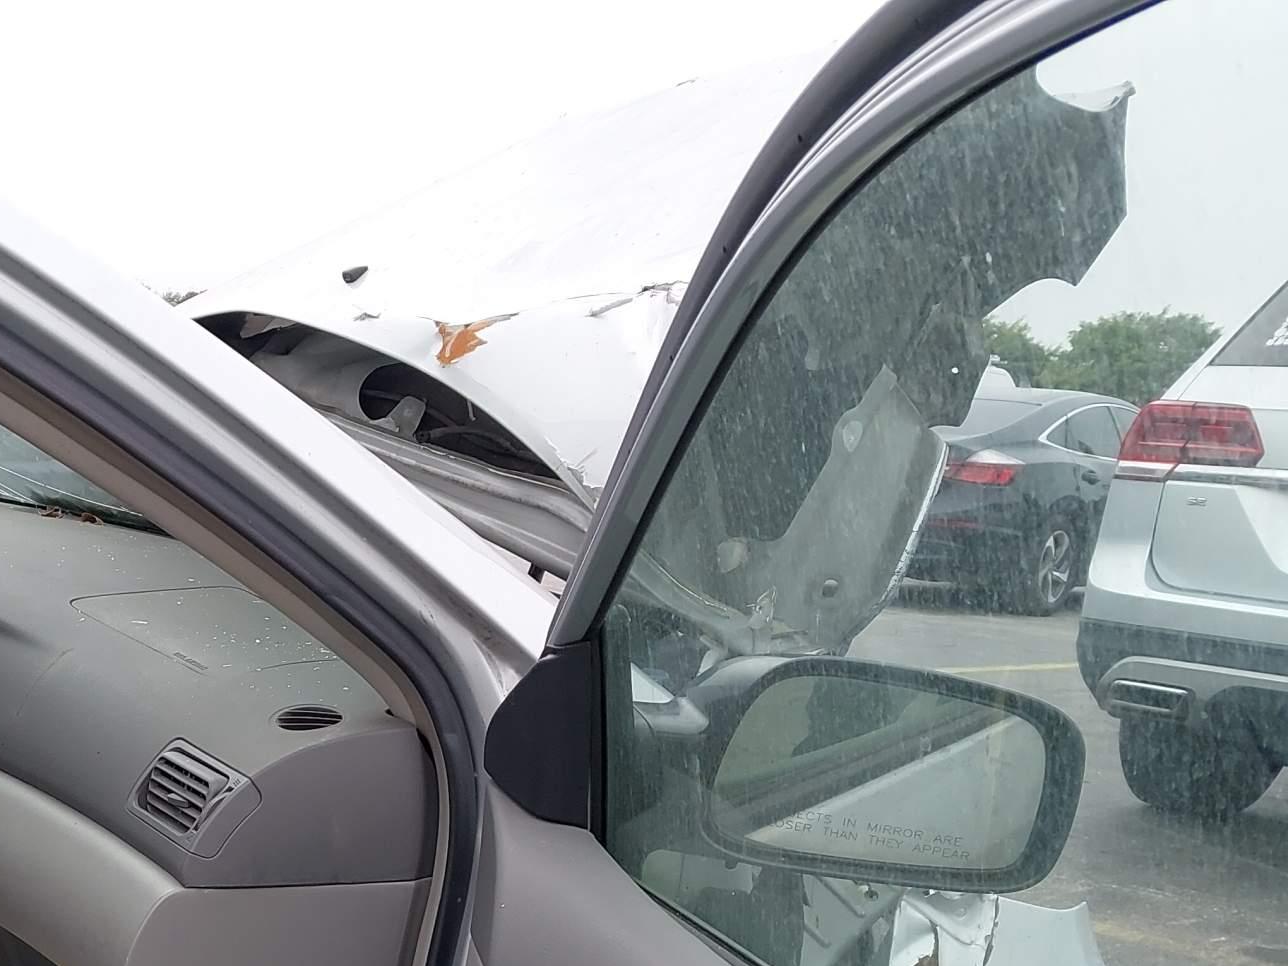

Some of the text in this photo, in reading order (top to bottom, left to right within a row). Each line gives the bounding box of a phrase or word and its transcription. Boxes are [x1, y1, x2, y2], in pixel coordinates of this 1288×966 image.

[822, 826, 860, 841] THAN
[868, 834, 904, 849] THEY
[911, 843, 971, 861] APPEAR
[842, 817, 858, 829] IN
[865, 822, 925, 840] MIRROR
[931, 836, 965, 848] ARE
